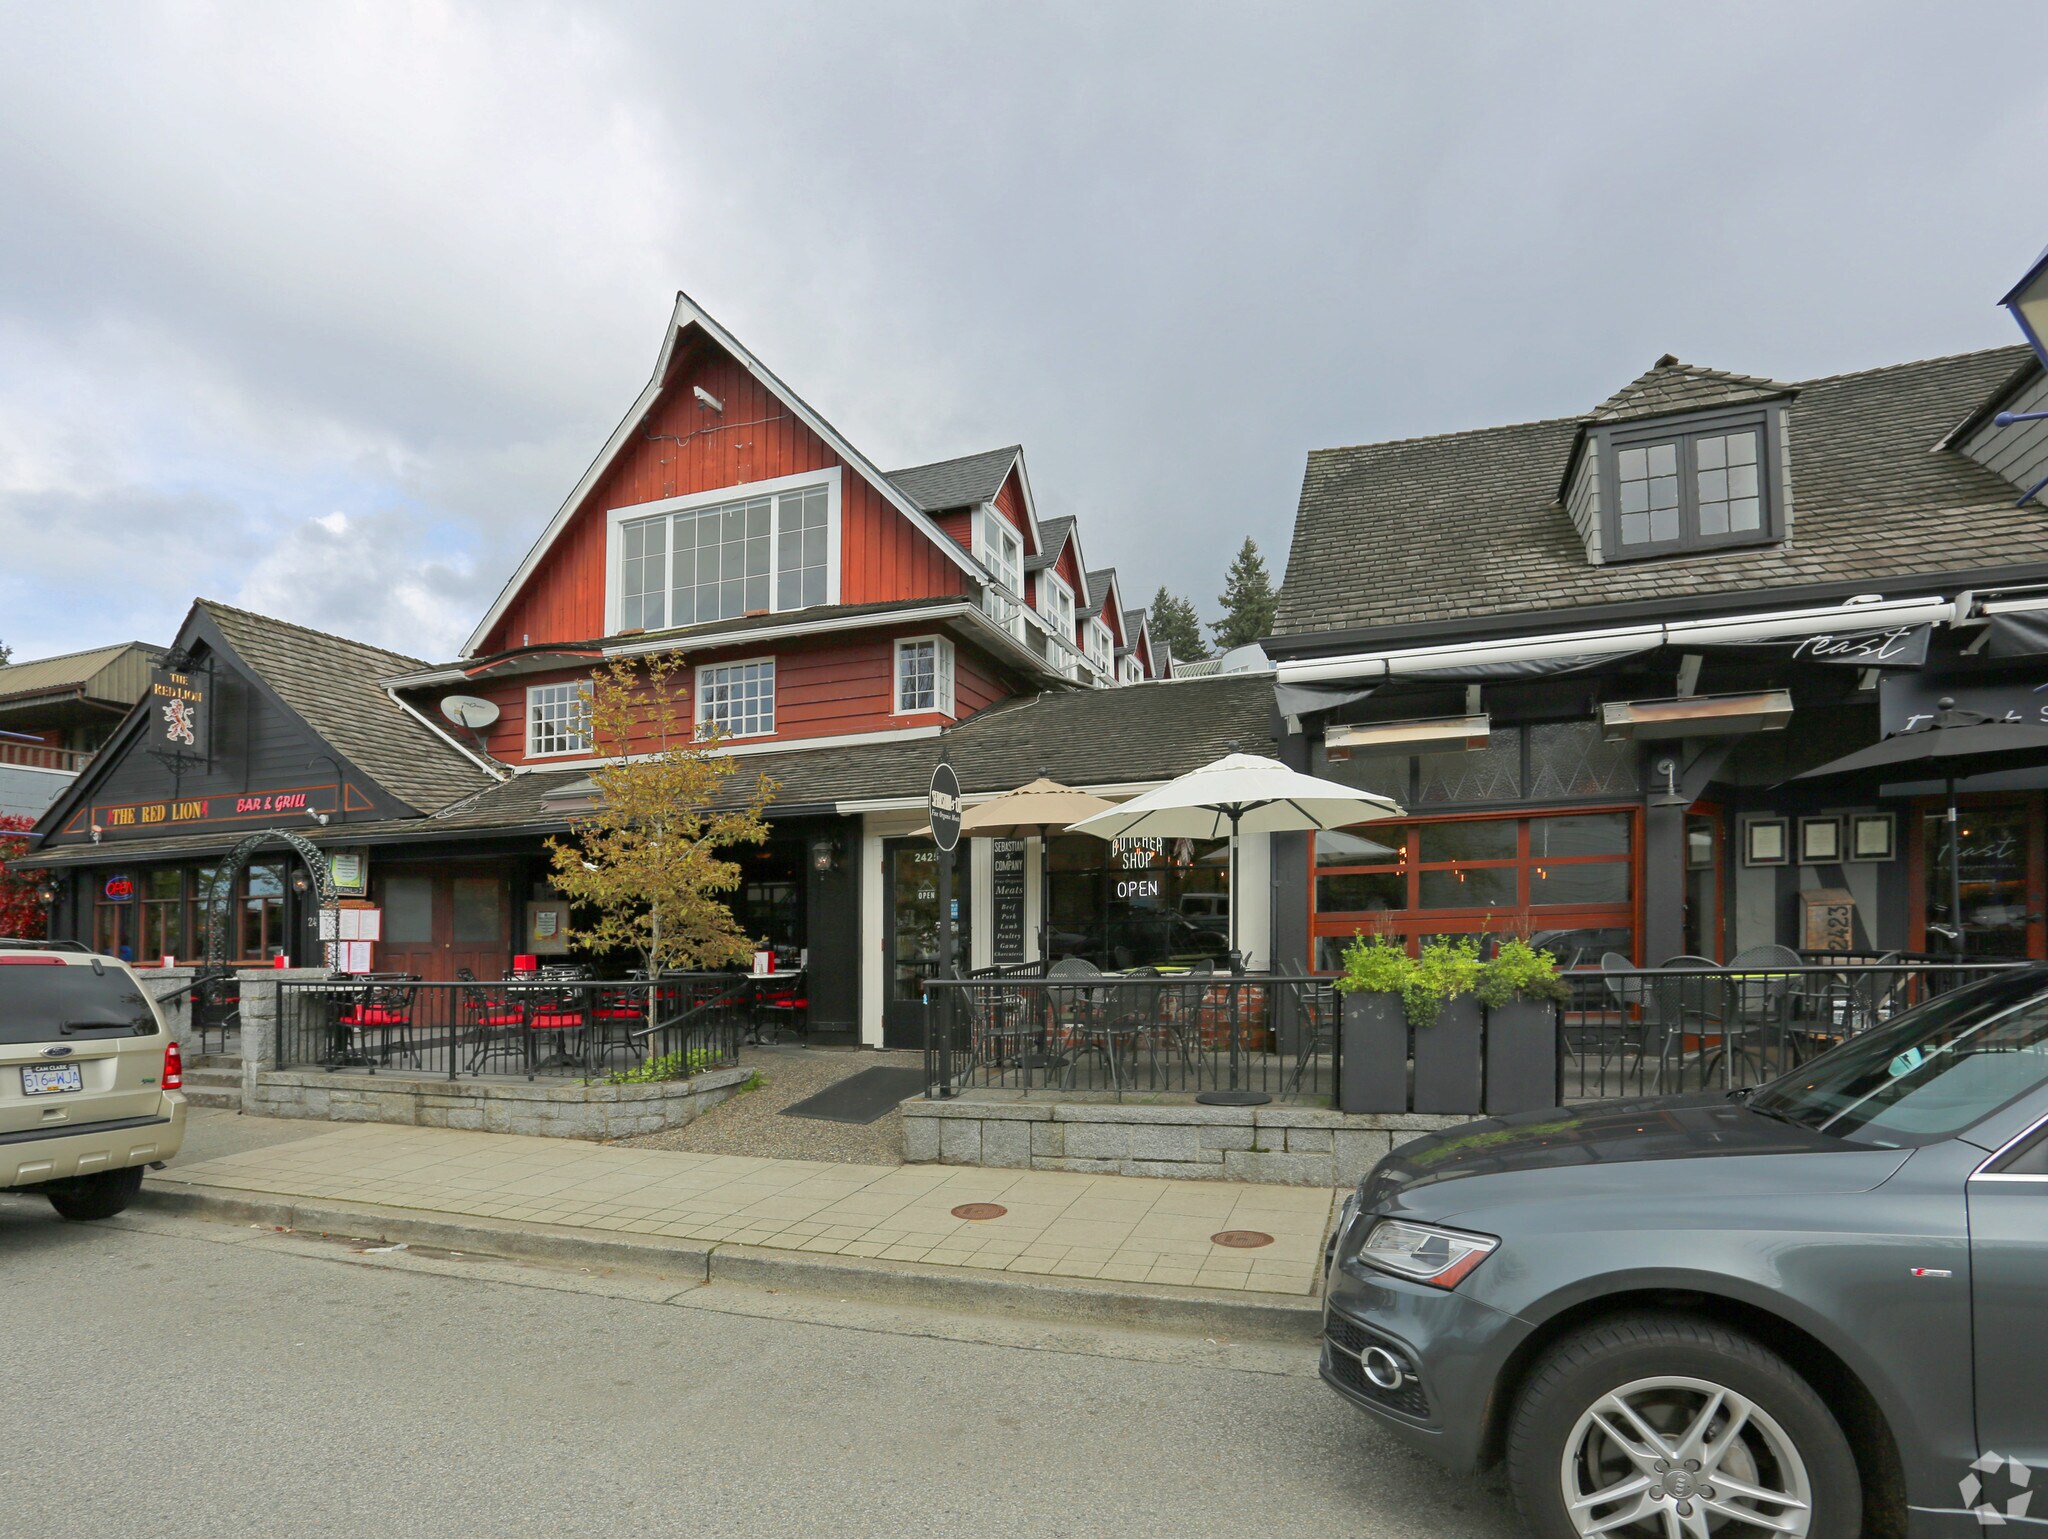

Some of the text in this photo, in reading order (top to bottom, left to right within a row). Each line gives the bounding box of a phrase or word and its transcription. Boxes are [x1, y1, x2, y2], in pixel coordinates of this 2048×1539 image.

[170, 673, 188, 685] THE
[154, 683, 202, 702] RED LION
[237, 794, 306, 813] BAR & GRILL
[113, 801, 200, 825] THE RED LION
[994, 841, 1024, 852] SEBASTIAN
[994, 860, 1023, 871] COMPANY
[1122, 851, 1152, 870] SHOP
[105, 881, 135, 895] OPEN
[995, 885, 1023, 895] Meats
[1117, 880, 1158, 898] OPEN
[918, 891, 935, 900] OPEN
[1001, 903, 1016, 911] Beef
[997, 932, 1021, 941] Poultry
